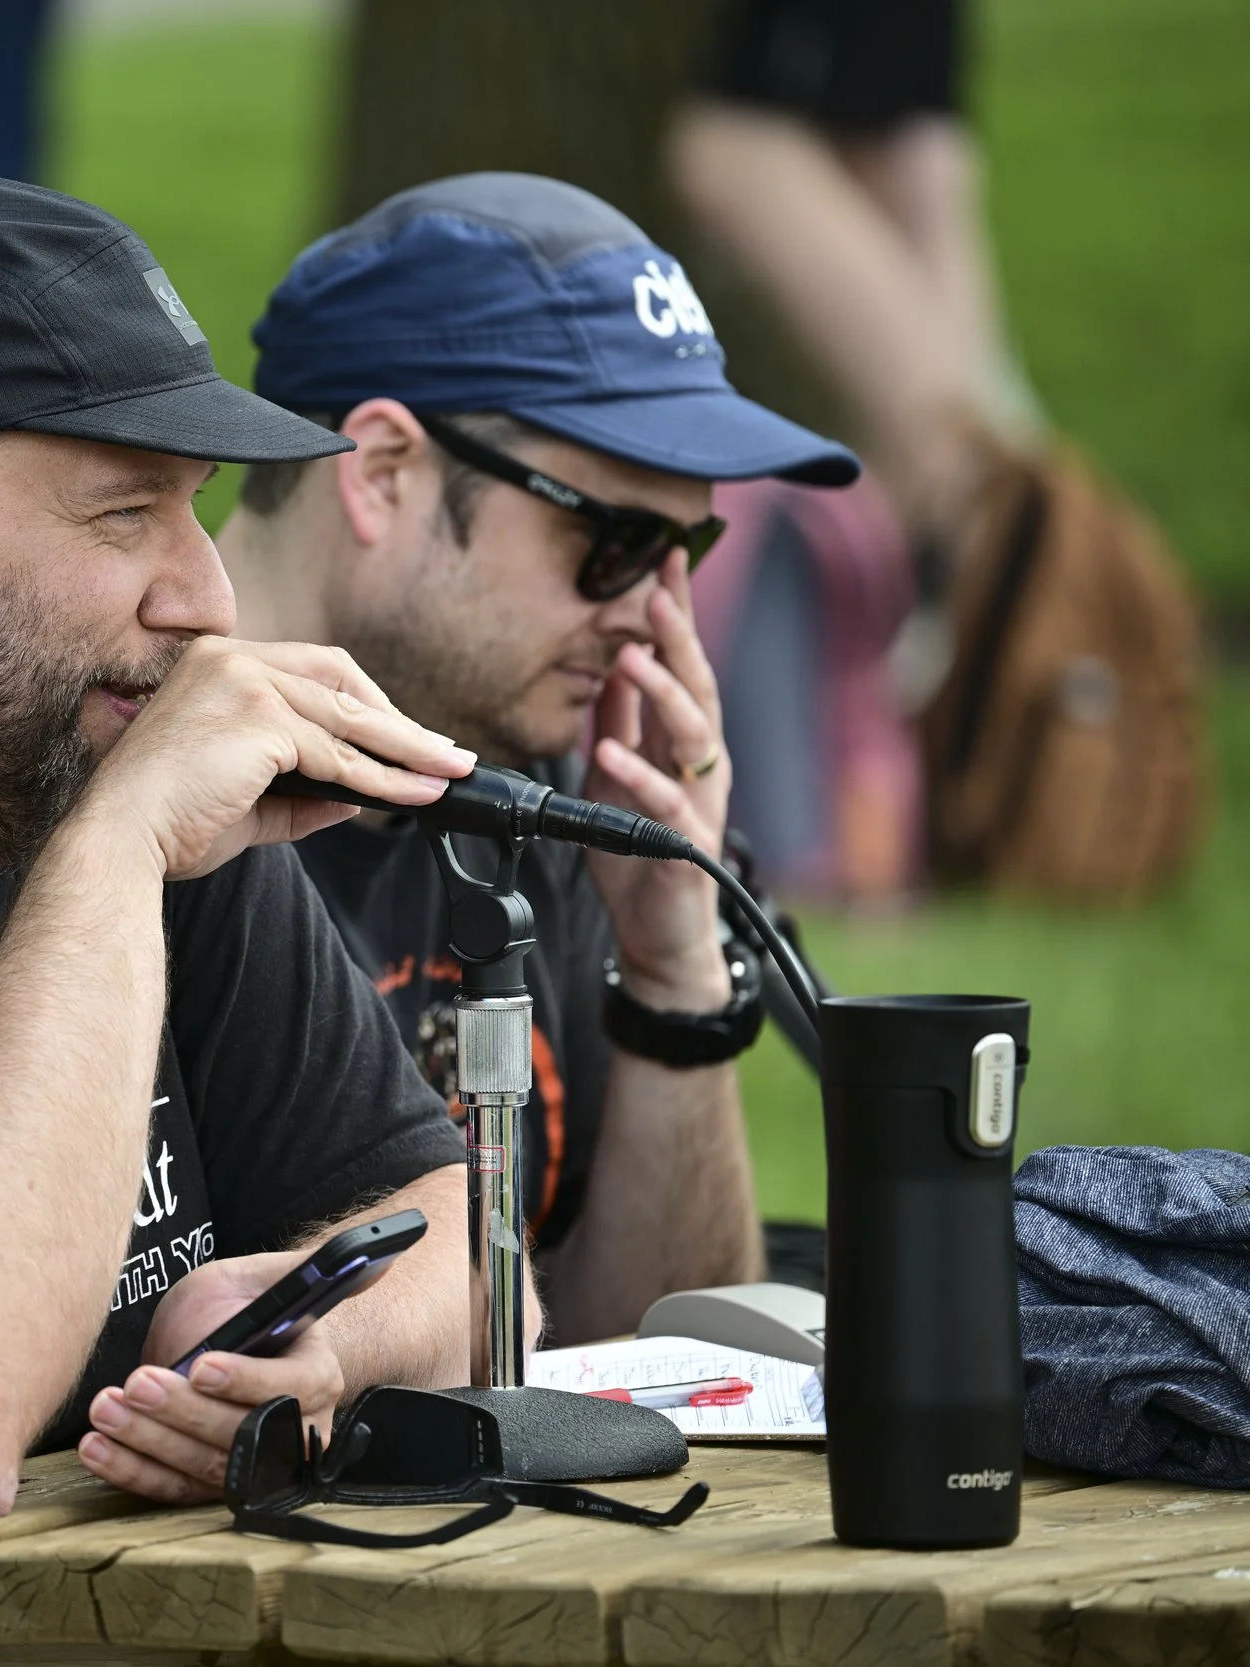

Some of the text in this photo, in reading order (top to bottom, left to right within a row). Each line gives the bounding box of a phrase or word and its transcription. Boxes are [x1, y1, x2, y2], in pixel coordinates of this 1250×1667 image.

[988, 1073, 1004, 1134] contigo
[171, 1221, 216, 1274] YO
[947, 1468, 1013, 1491] contigo
